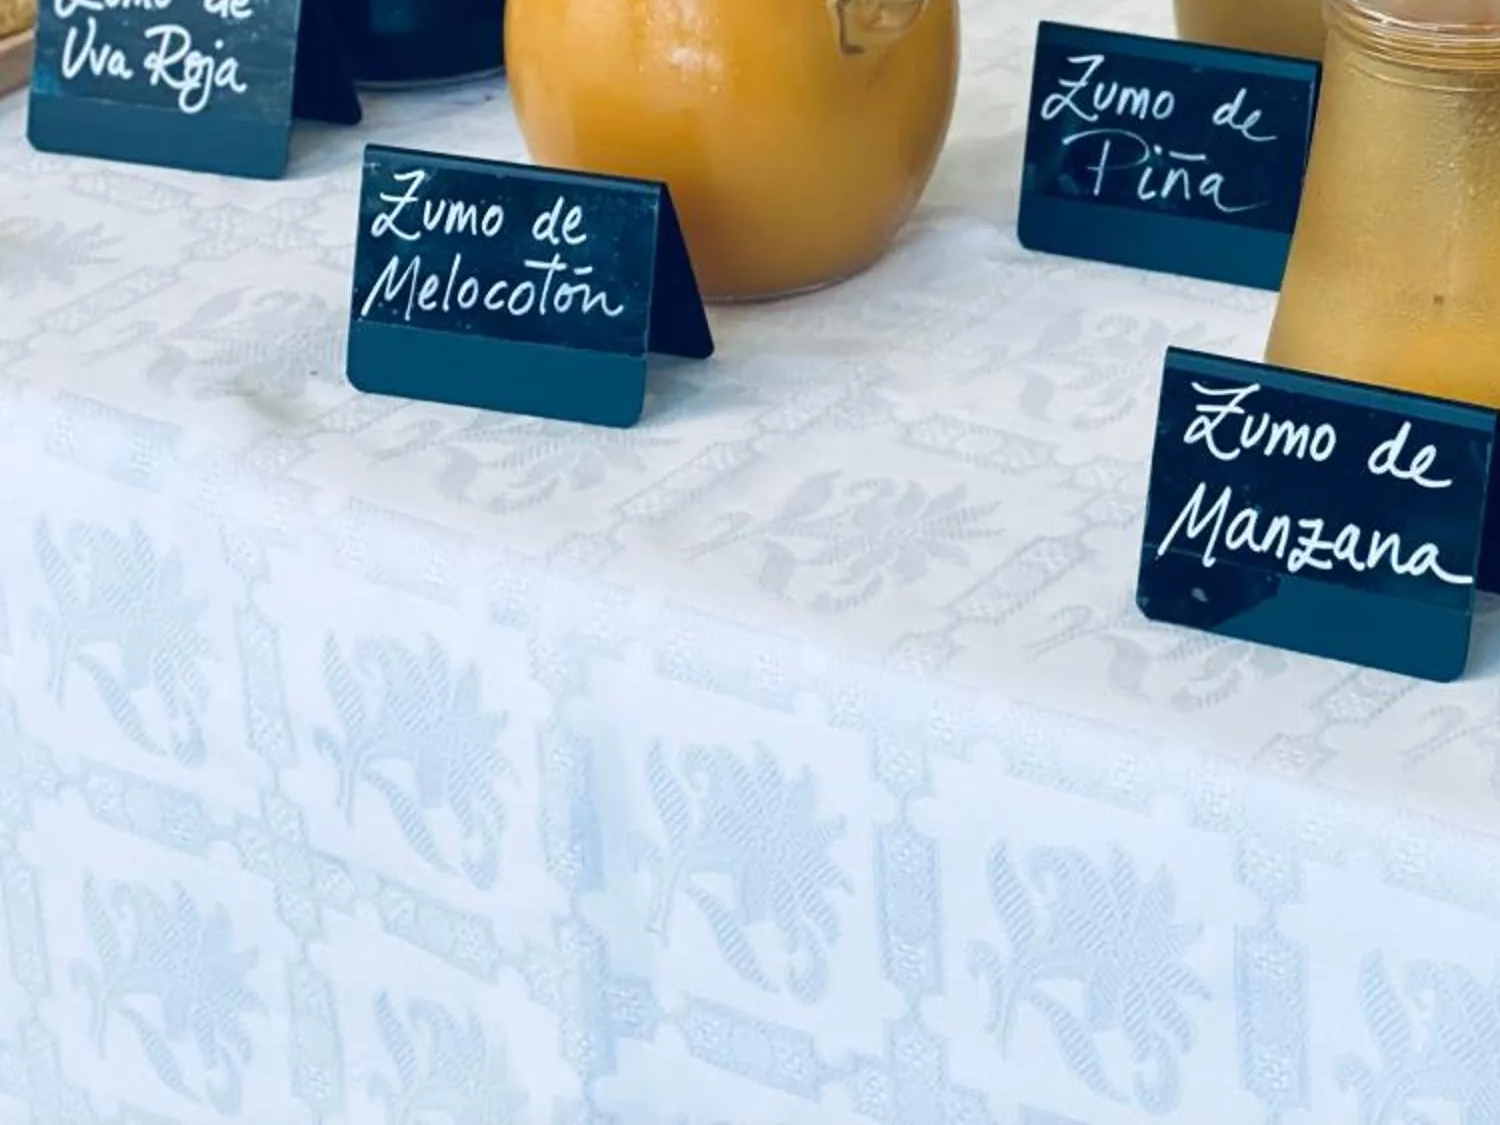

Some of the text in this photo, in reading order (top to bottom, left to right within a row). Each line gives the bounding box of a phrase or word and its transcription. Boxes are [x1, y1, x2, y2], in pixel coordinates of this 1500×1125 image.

[143, 24, 248, 114] Roja
[1040, 54, 1278, 141] Zumo de
[370, 169, 588, 245] Zumo de
[1062, 128, 1271, 212] Piña
[1183, 381, 1452, 488] Zumo de
[1155, 481, 1474, 584] Manzana
